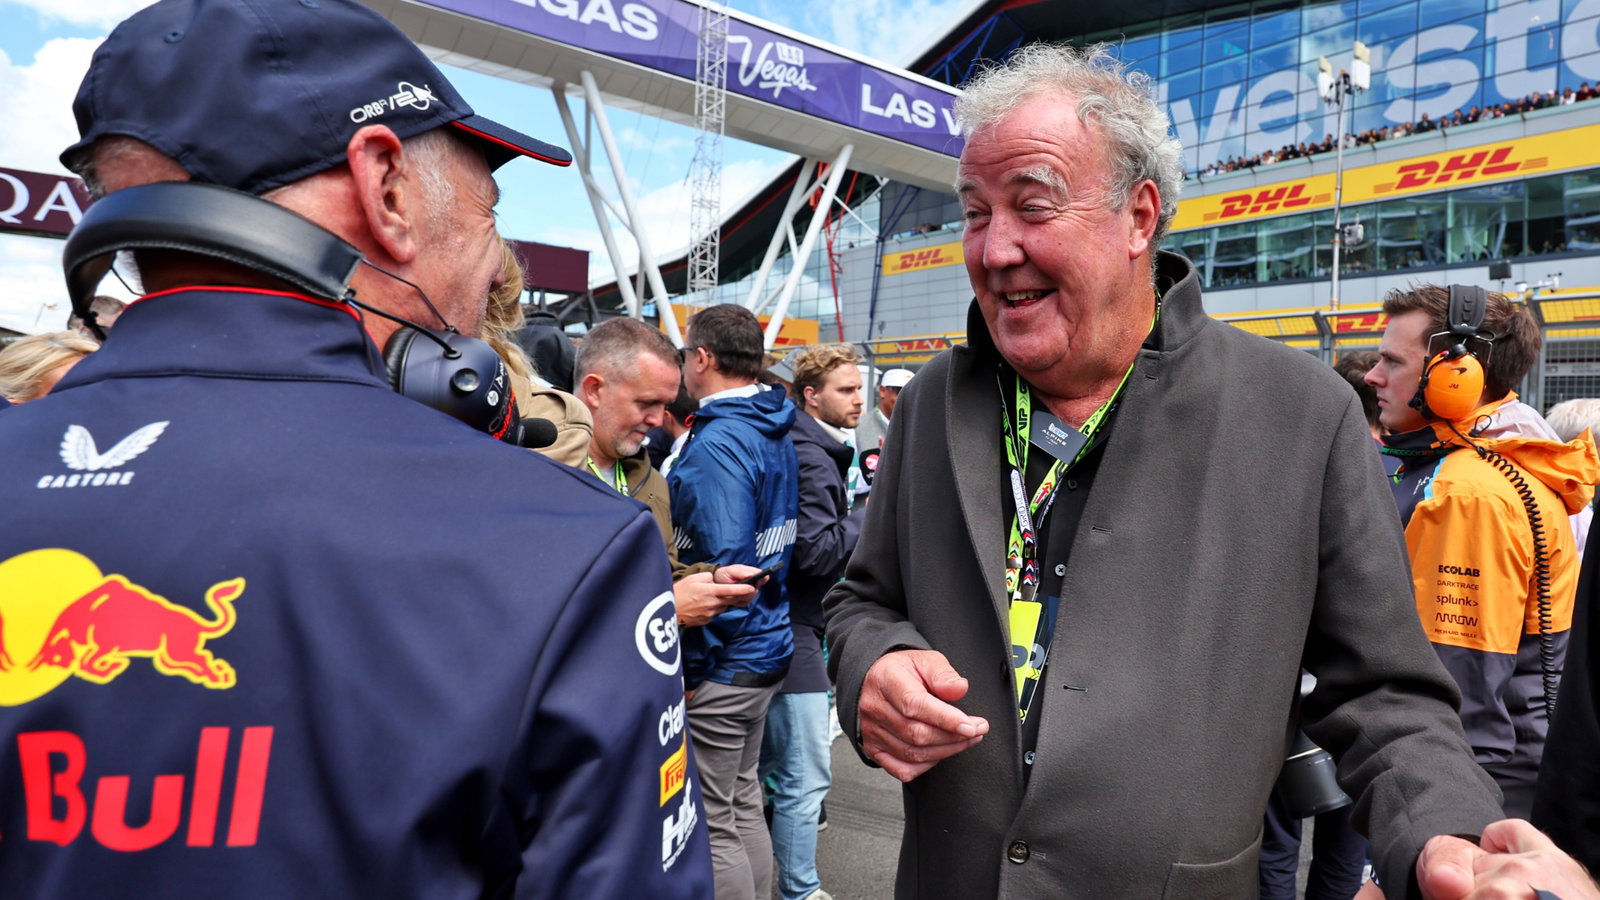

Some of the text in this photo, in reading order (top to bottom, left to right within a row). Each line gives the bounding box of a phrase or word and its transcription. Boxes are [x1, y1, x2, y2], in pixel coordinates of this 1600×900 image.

[727, 35, 817, 98] Vegas
[862, 84, 936, 129] LAS
[1396, 147, 1522, 190] DHL
[1220, 184, 1312, 218] DHL
[900, 248, 945, 269] DHL
[1019, 408, 1028, 431] VIP
[1042, 429, 1067, 446] ALPINE
[37, 471, 135, 489] CASTORE
[1438, 564, 1480, 577] ECOLAB
[1437, 580, 1479, 590] DARKTRACE
[1436, 594, 1479, 607] splunk>
[649, 613, 678, 653] Ess
[1434, 628, 1459, 636] RICHARD
[17, 726, 274, 852] Bull
